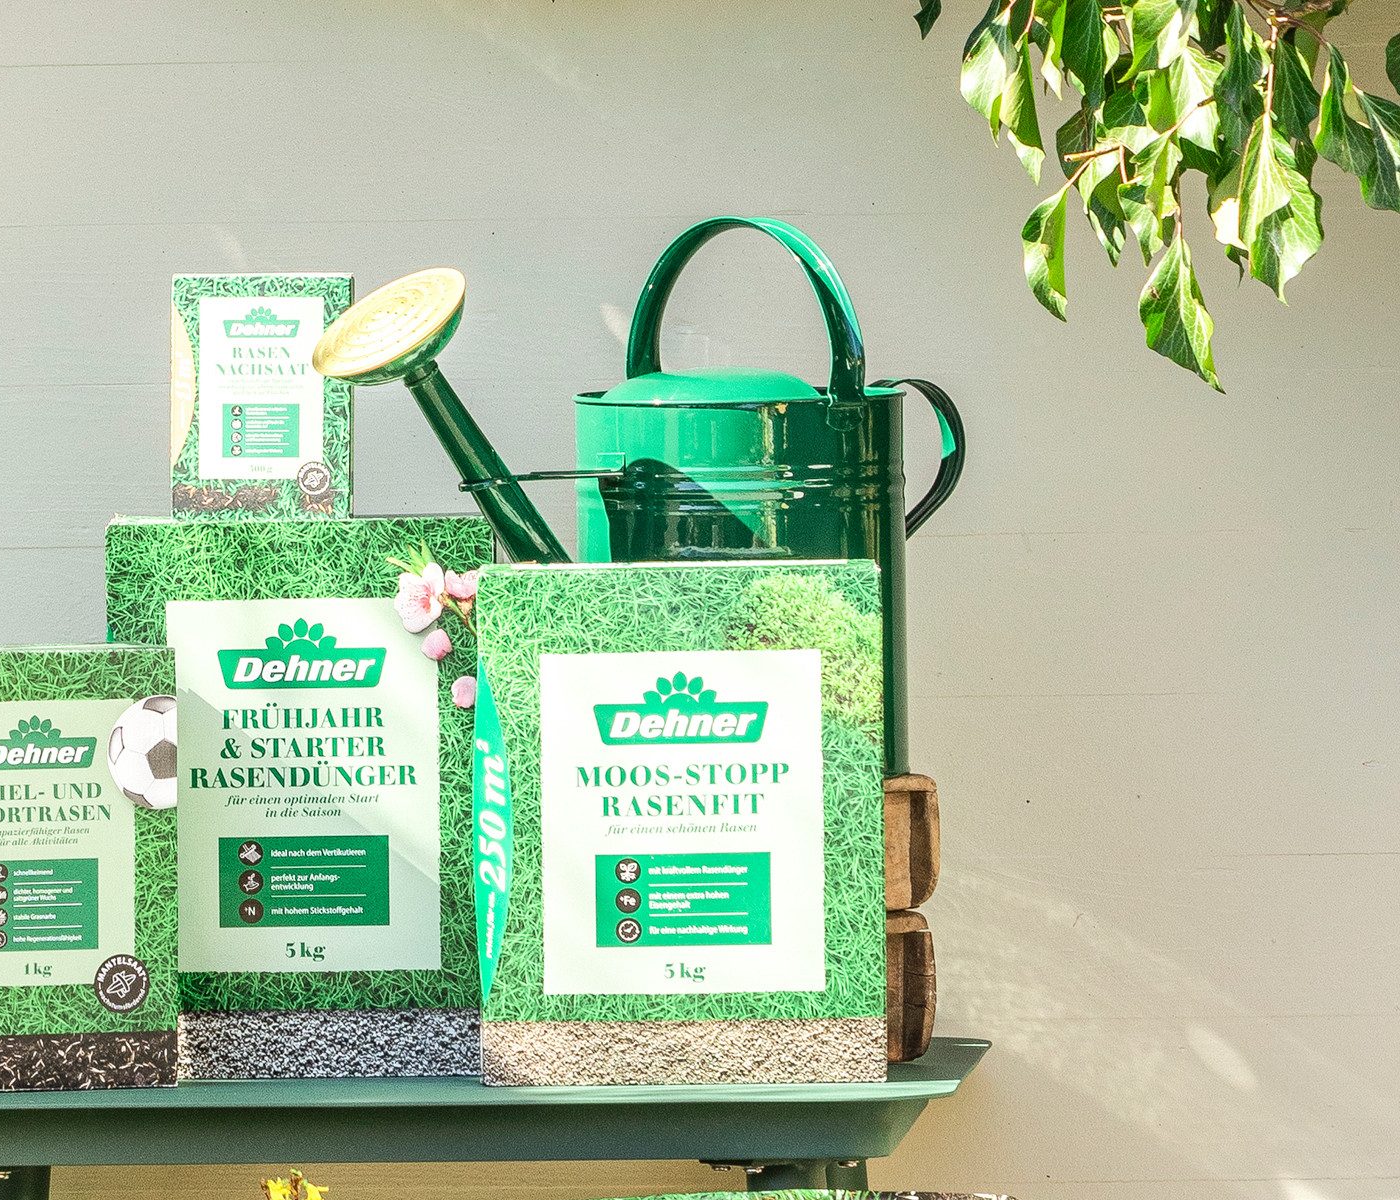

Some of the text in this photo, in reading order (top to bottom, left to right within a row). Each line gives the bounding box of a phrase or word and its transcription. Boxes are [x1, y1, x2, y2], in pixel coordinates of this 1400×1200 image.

[232, 346, 291, 359] RASEN
[216, 363, 309, 376] NACHSAAT
[233, 655, 376, 683] Dehner
[221, 702, 385, 730] FRÜHJAHR
[609, 709, 758, 739] Dehner
[220, 736, 386, 760] & STARTER
[189, 760, 418, 789] RASENDÜNGER
[575, 763, 789, 788] MOOS-STOPP
[53, 782, 102, 800] UND
[225, 793, 380, 808] für einen optimalen Start
[601, 793, 764, 817] RASENFIT
[265, 807, 342, 818] in die Saison
[63, 826, 90, 835] Rasen
[605, 822, 757, 836] für einen schönen Rasen
[12, 838, 28, 846] alle
[30, 837, 78, 846] Aktivitäten
[288, 849, 306, 857] nach
[306, 849, 322, 857] dem
[322, 848, 366, 857] Vertikutieren
[479, 810, 508, 893] 250
[271, 874, 296, 883] perfekt
[309, 873, 340, 883] Anfangs-
[271, 883, 314, 892] entwicklung
[271, 906, 363, 916] mit hohem Stickstoffgehalt
[285, 942, 326, 962] 5 kg
[34, 963, 53, 978] kg
[97, 956, 146, 982] MANTELSAAT
[665, 963, 706, 983] 5 kg
